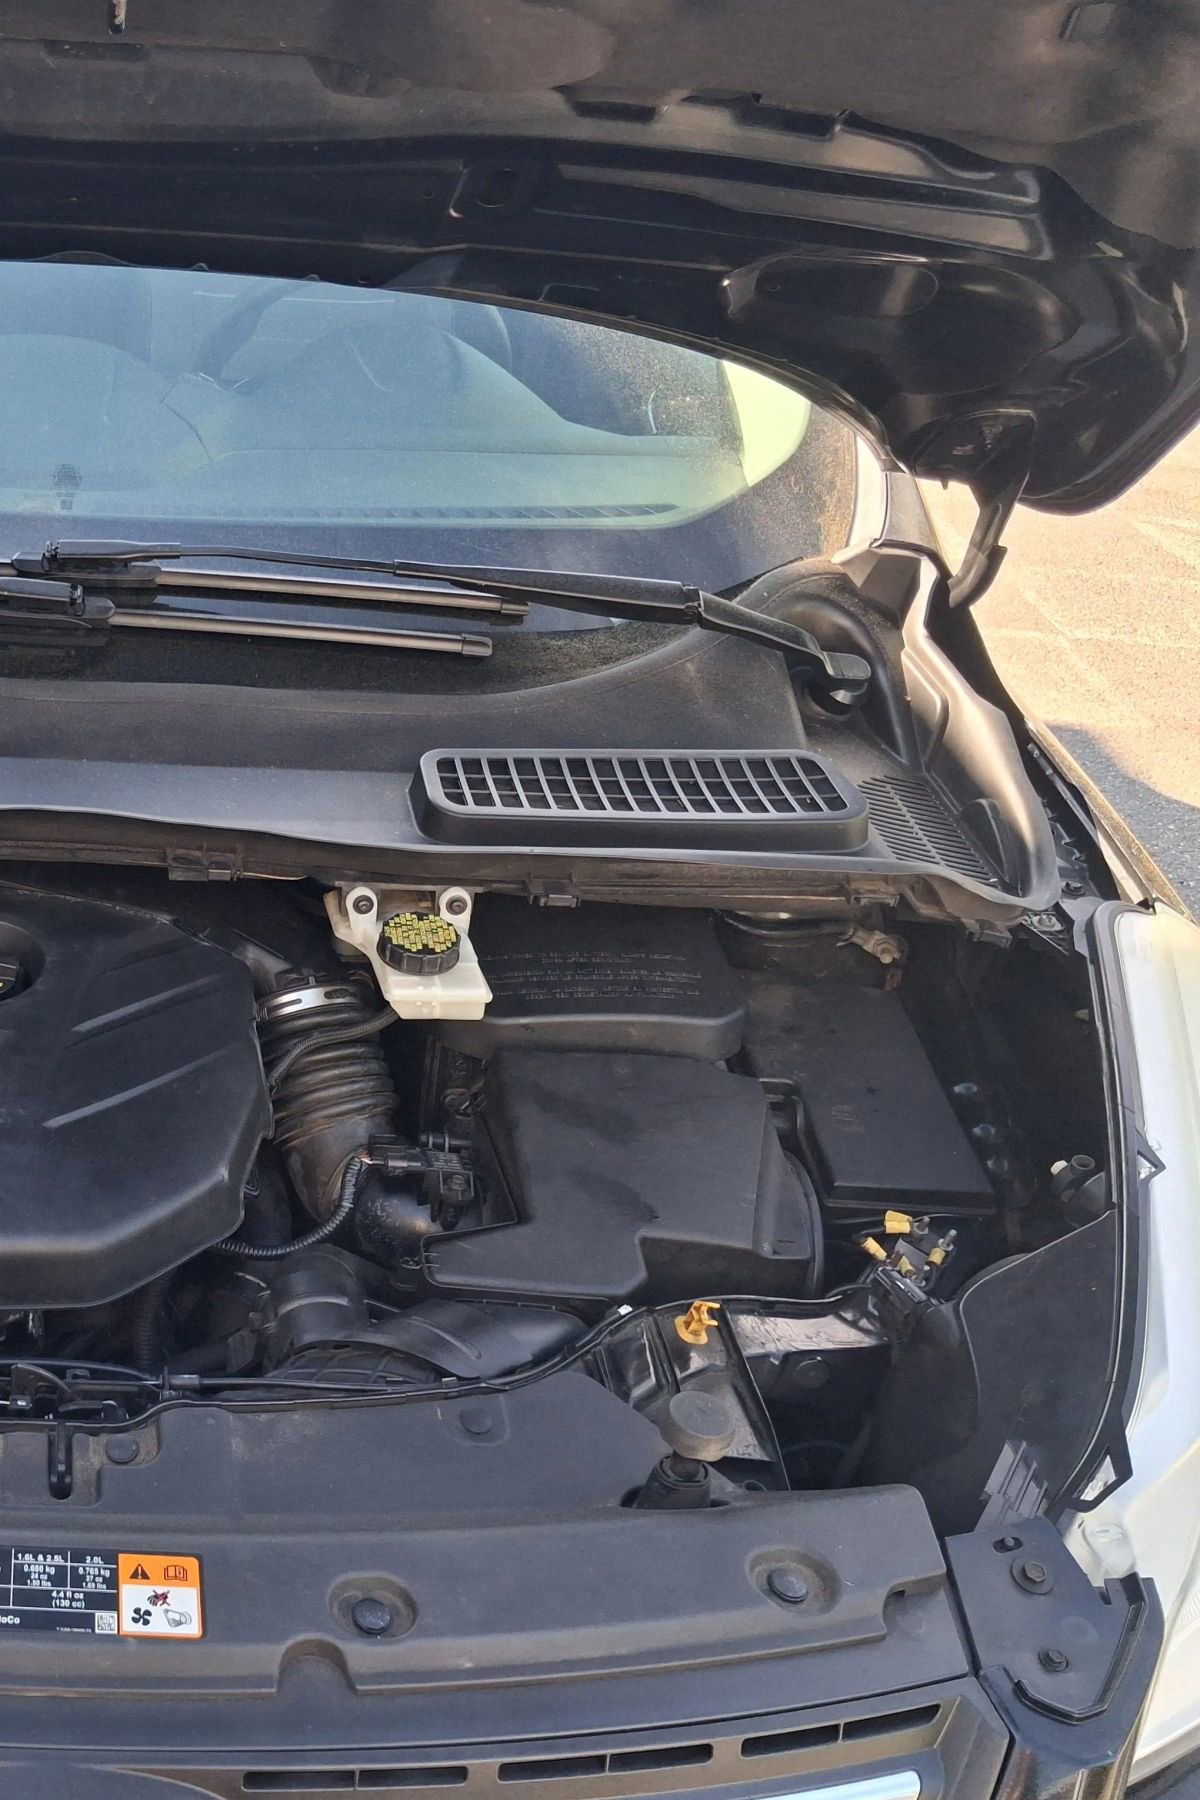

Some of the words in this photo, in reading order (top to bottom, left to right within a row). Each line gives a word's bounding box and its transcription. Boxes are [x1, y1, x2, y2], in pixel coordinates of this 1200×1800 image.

[86, 1556, 104, 1564] 2.0L
[45, 1565, 55, 1575] kg
[100, 1568, 110, 1577] kg
[51, 1590, 64, 1598] 4.4
[52, 1599, 70, 1608] (130
[71, 1600, 85, 1609] cc)
